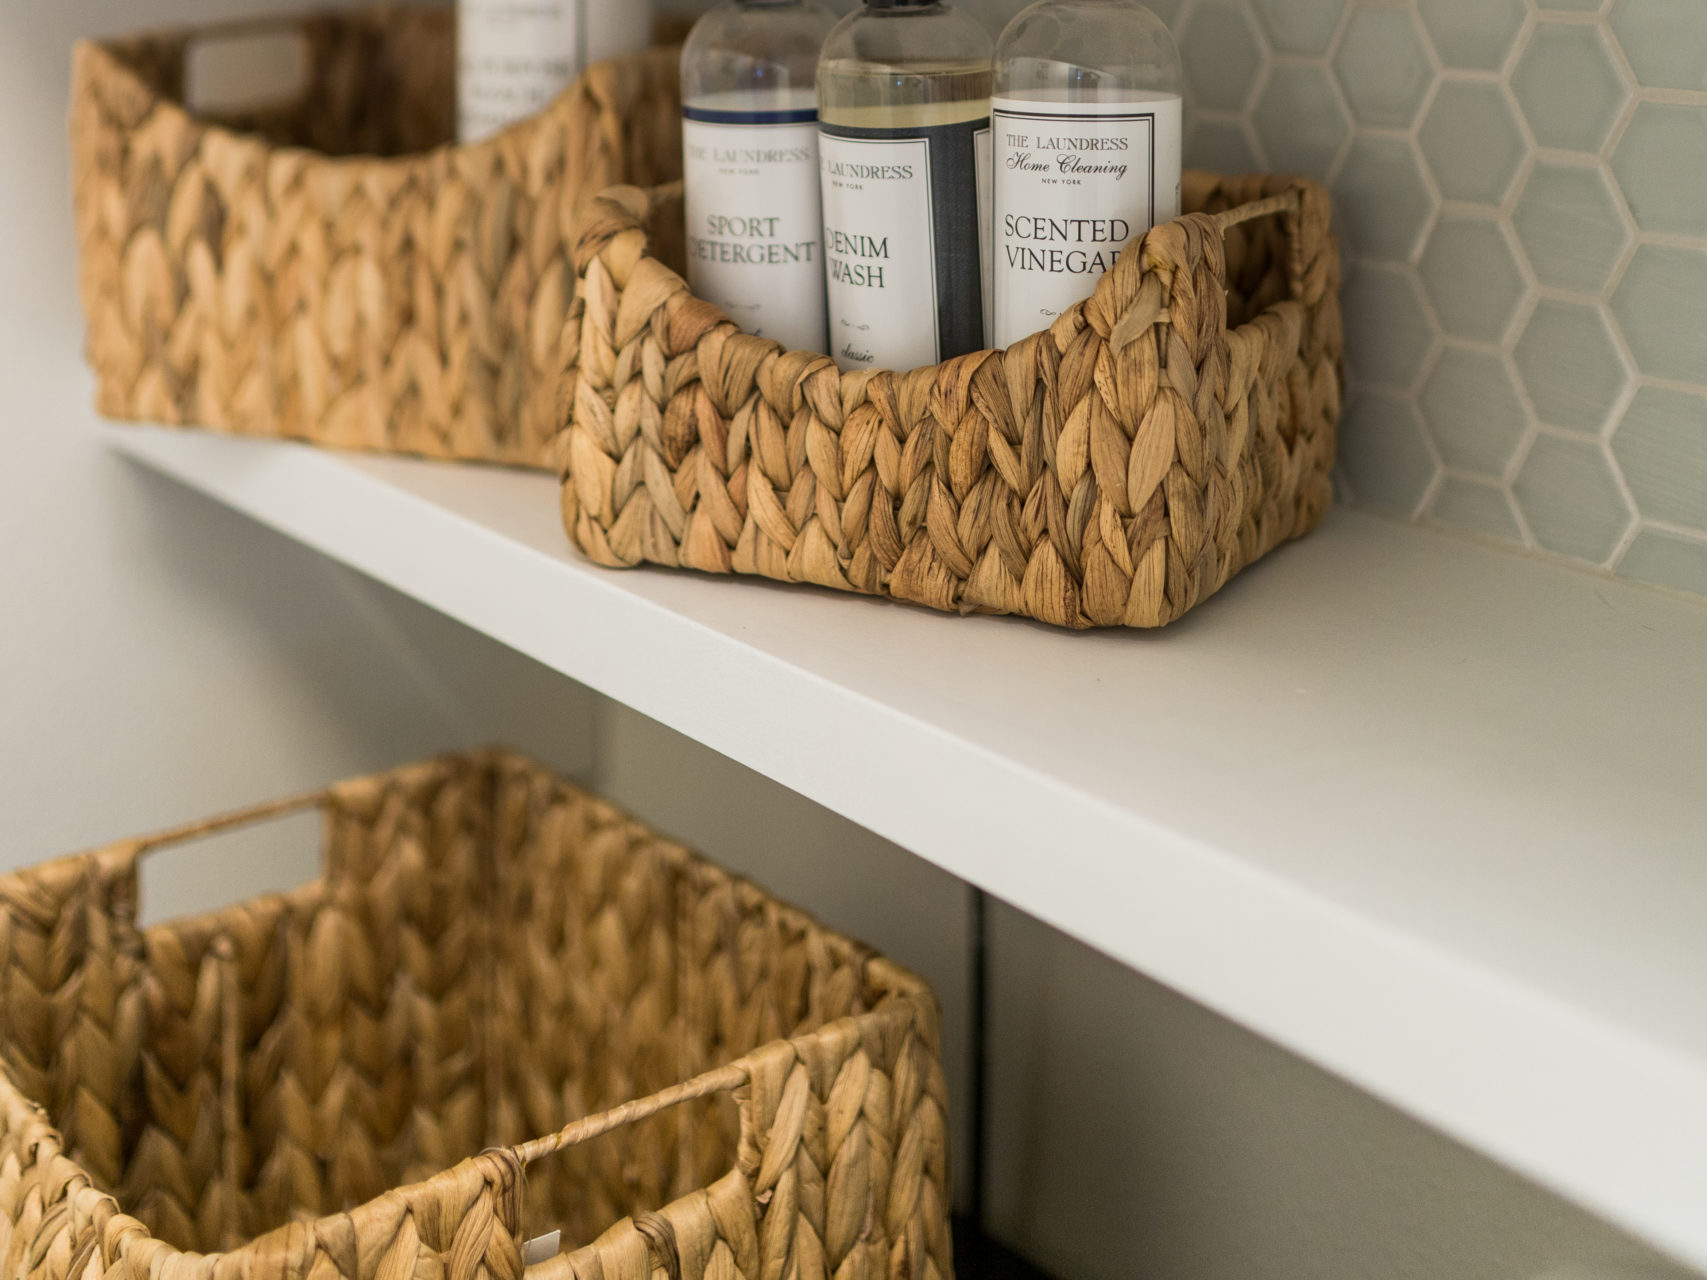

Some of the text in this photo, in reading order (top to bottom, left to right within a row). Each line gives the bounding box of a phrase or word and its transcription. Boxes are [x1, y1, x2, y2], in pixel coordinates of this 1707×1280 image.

[1006, 133, 1129, 151] THE LAUNDRESS
[713, 147, 810, 164] LAUNDRESS
[1006, 151, 1128, 181] Home Cleaning
[828, 159, 914, 181] LAUNDRESS
[707, 214, 780, 238] SPORT
[1005, 214, 1130, 243] SCENTED
[826, 227, 890, 260] DENIM
[829, 257, 885, 289] WASH
[841, 342, 876, 365] classic
